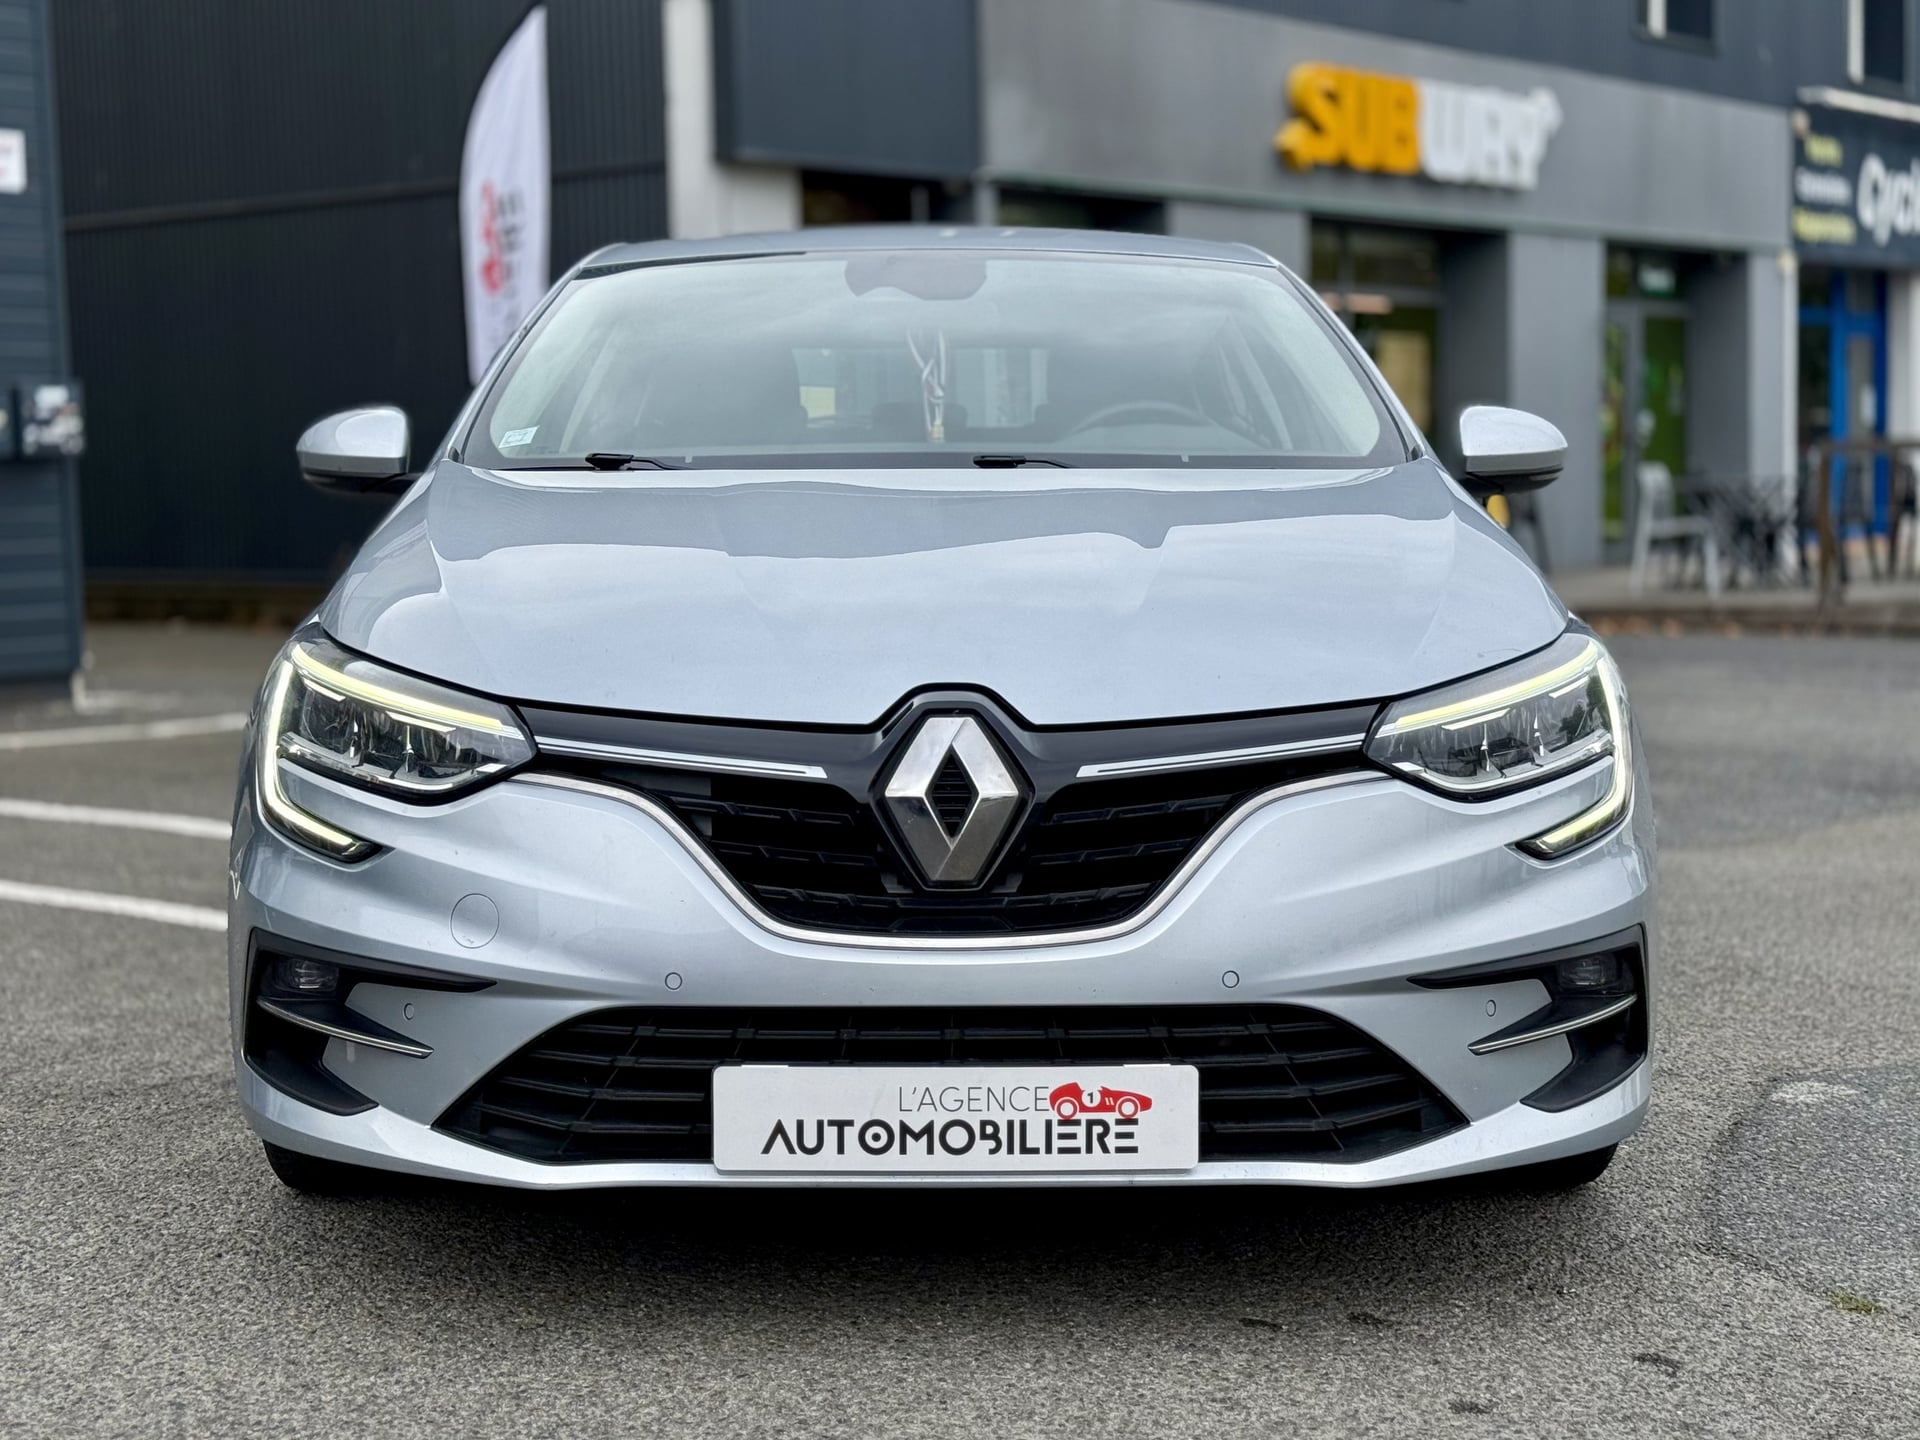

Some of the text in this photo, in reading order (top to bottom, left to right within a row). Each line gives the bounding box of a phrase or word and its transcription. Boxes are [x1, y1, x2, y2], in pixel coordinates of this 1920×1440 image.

[1275, 61, 1561, 190] SUBWAY
[898, 1086, 1050, 1112] L'AGENCE
[1086, 1091, 1095, 1105] 1
[760, 1118, 1139, 1155] AUTOMOBILIERE
